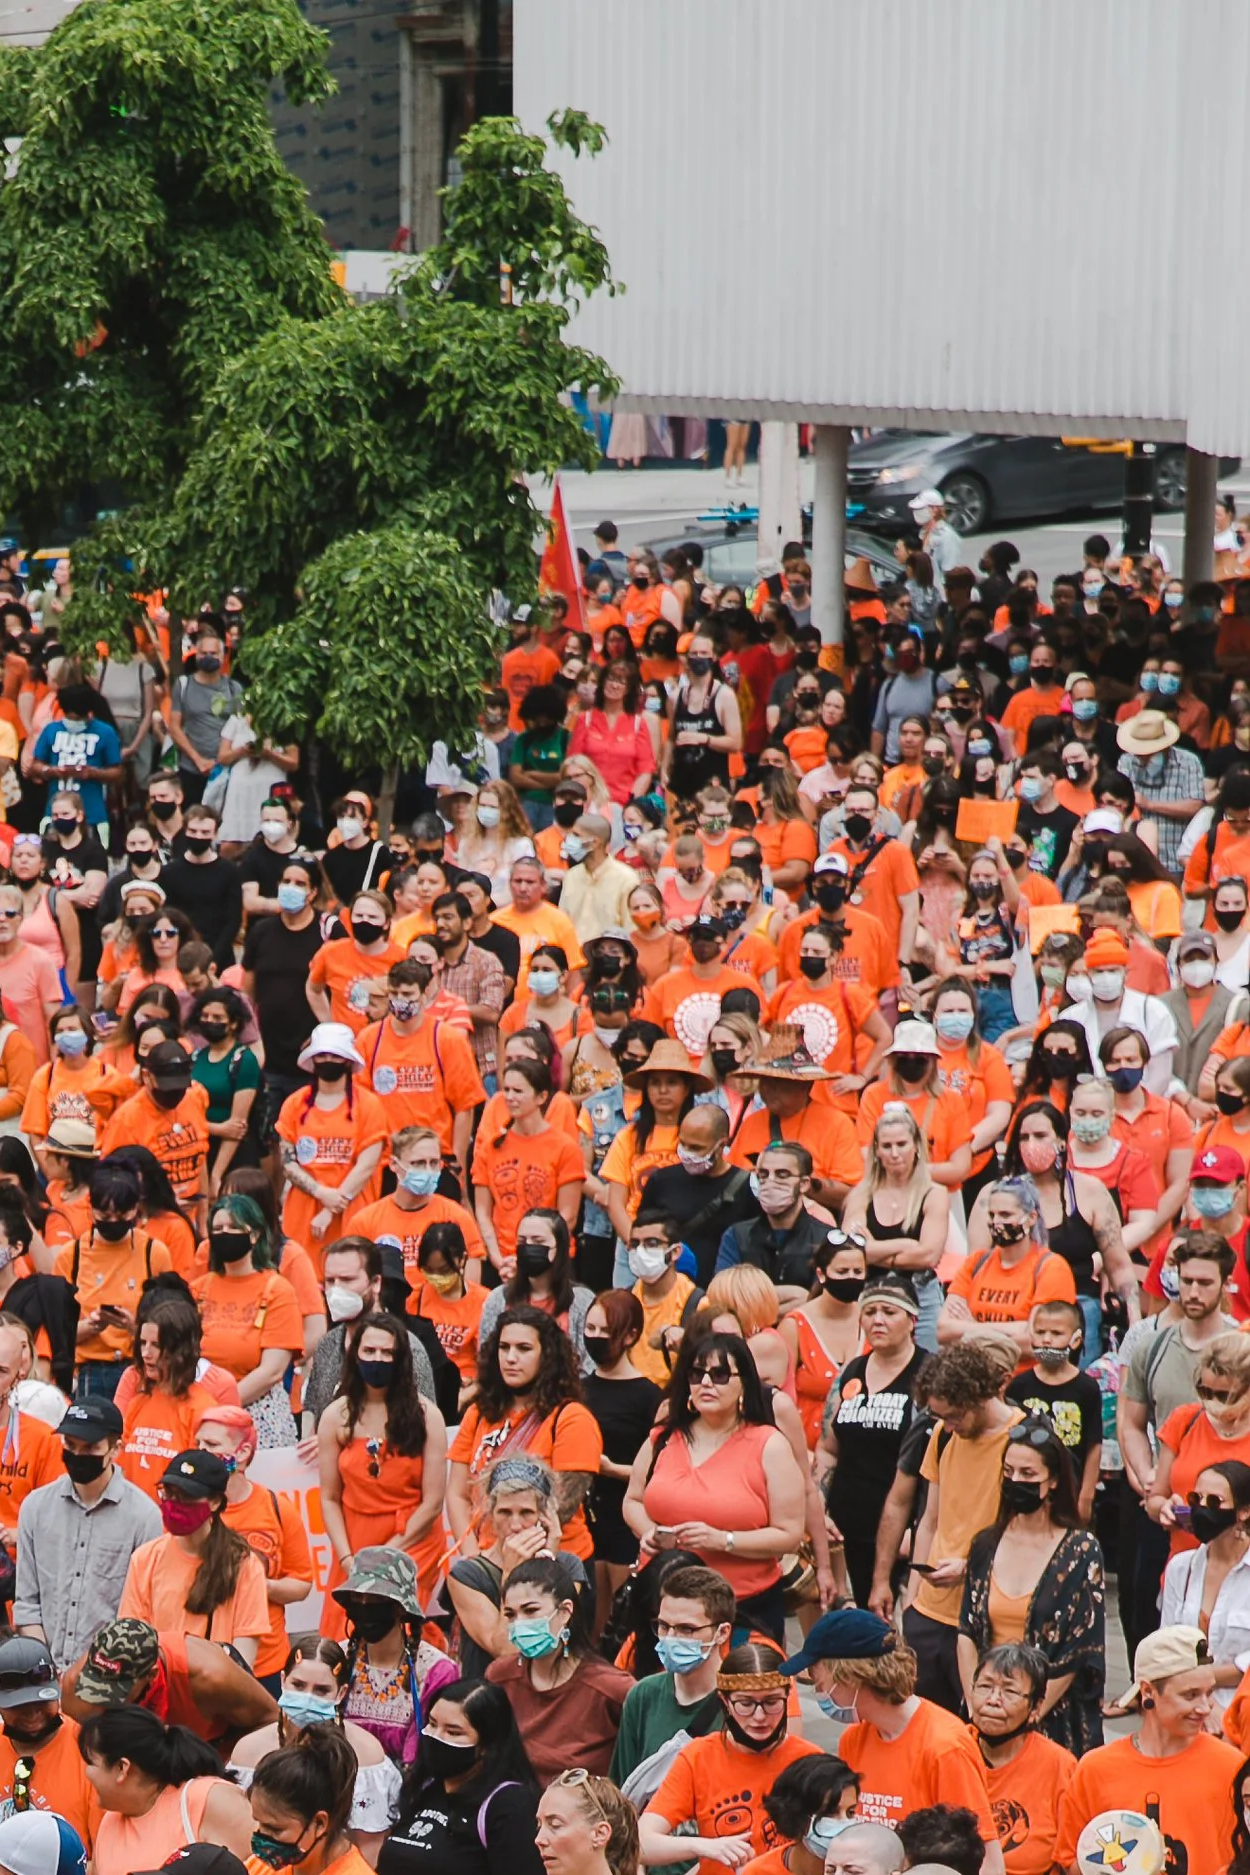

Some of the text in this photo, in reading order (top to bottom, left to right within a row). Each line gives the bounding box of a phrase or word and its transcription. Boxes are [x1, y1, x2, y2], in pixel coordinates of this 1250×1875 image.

[52, 731, 100, 756] JUST
[978, 1287, 1020, 1305] EVERY
[867, 1392, 908, 1410] TODAY
[837, 1406, 904, 1424] COLONIZER
[861, 1805, 888, 1819] FOR
